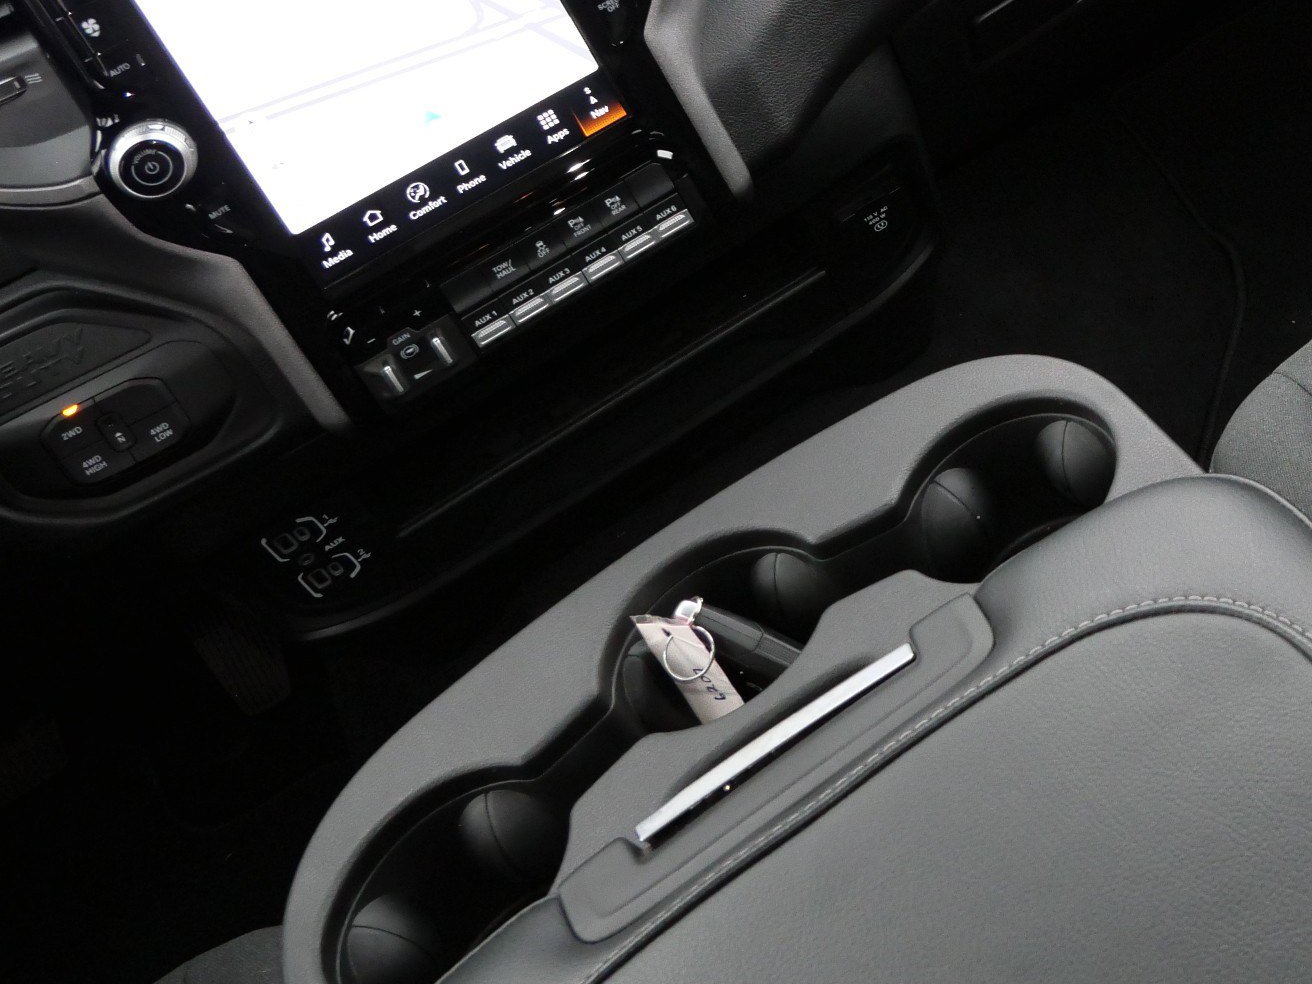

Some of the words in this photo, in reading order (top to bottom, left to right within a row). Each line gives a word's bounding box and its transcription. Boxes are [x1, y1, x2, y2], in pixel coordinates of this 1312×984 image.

[607, 3, 620, 13] OFF
[109, 62, 131, 78] AUTO
[590, 105, 609, 120] Nav
[547, 128, 570, 145] Apps
[498, 147, 532, 171] Vehicle
[457, 173, 486, 194] Phone
[208, 204, 231, 220] MUTE
[409, 195, 447, 221] Comfort
[656, 208, 671, 221] AUX
[368, 223, 398, 244] Home
[621, 229, 636, 242] AUX
[322, 247, 354, 270] Media
[538, 247, 551, 258] OFF
[585, 250, 600, 263] AUX
[496, 266, 517, 280] HAUL
[548, 271, 564, 284] AUX
[511, 291, 527, 305] AUX
[474, 313, 491, 327] AUX
[392, 331, 412, 346] GAIN
[61, 426, 83, 441] 2WD
[150, 422, 170, 436] 4WD
[154, 429, 174, 443] LOW
[82, 454, 102, 469] 4WD
[85, 461, 108, 476] HIGH
